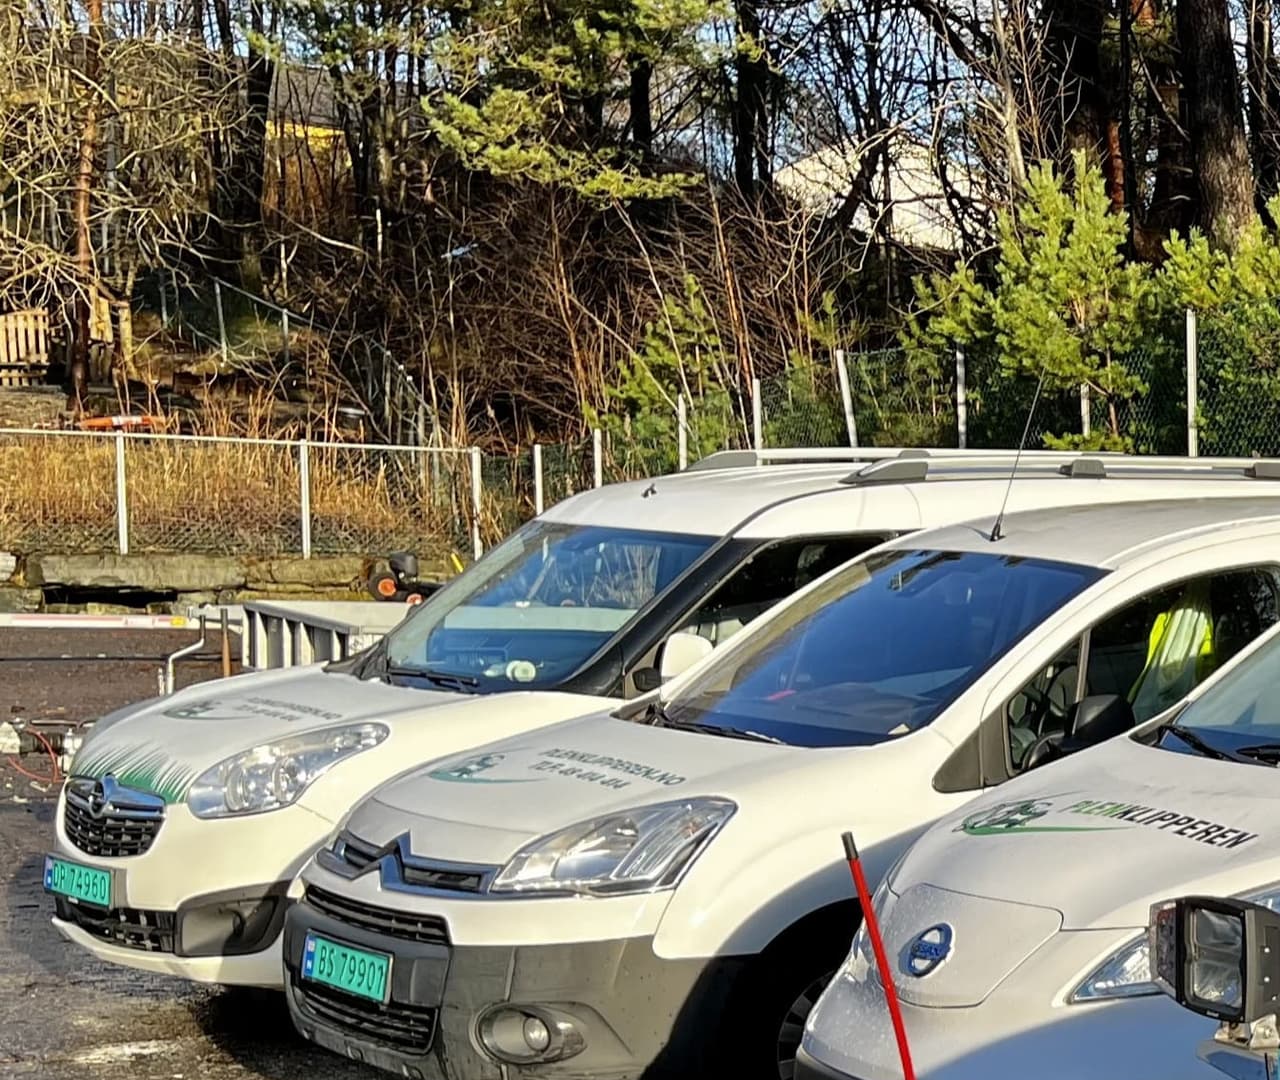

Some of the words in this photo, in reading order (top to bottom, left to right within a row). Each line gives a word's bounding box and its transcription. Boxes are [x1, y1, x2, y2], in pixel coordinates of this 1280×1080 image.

[1058, 799, 1259, 849] PLENKLIPPEREN
[319, 945, 335, 978] BS
[340, 952, 385, 995] 79901
